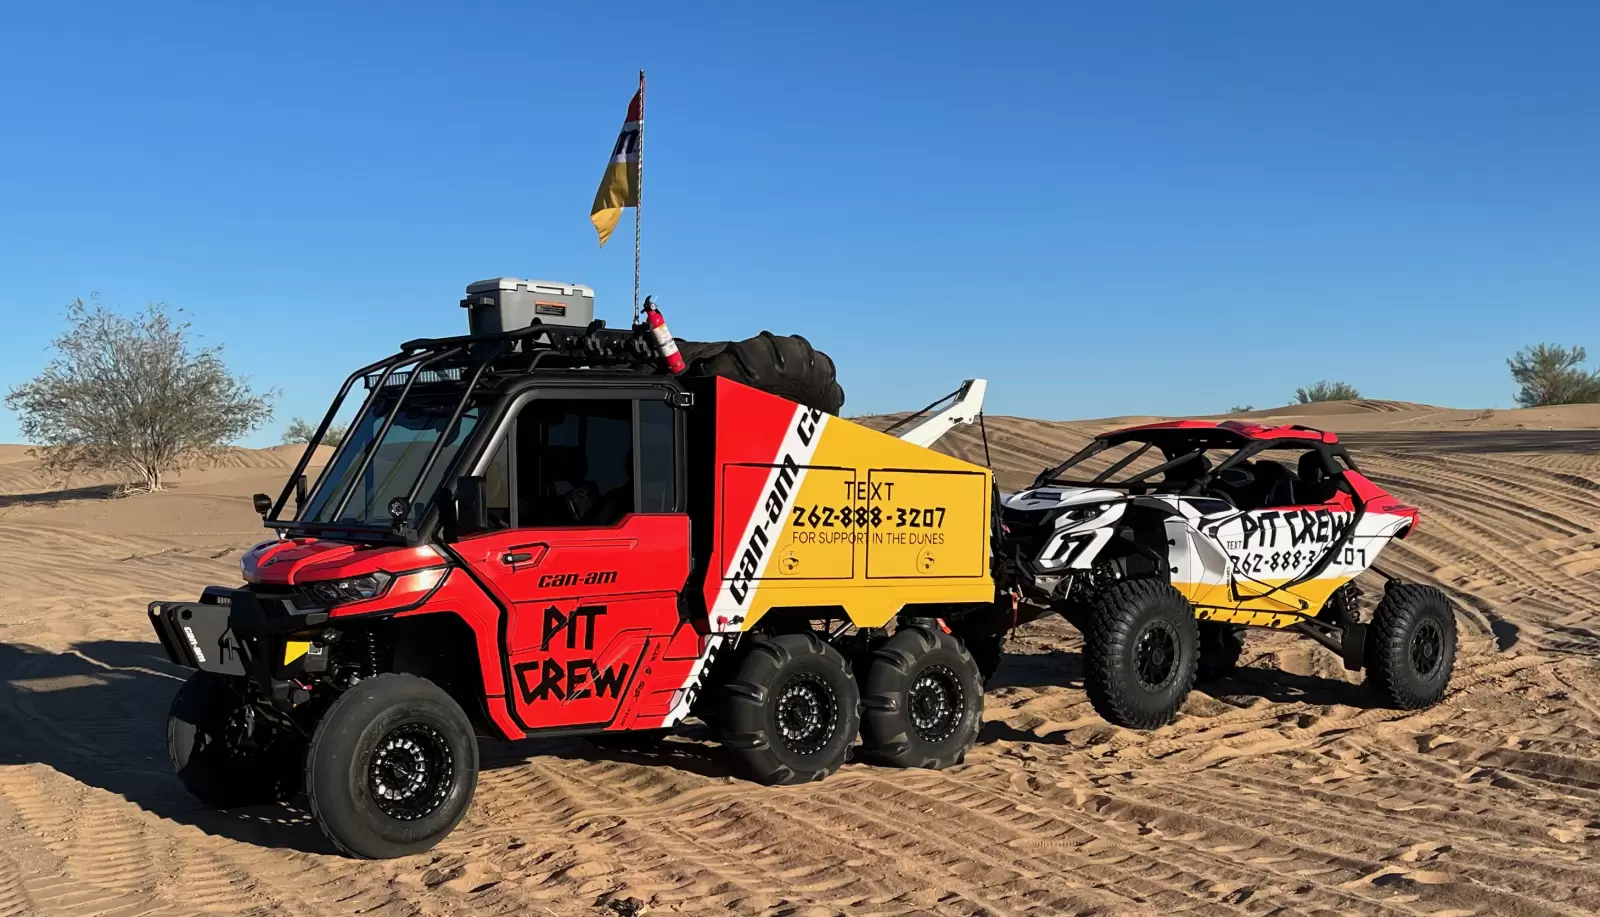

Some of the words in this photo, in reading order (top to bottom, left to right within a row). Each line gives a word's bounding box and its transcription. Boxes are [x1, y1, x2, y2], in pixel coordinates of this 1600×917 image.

[844, 481, 894, 501] TEXT
[792, 504, 946, 529] 262-888-3207
[1240, 510, 1281, 550] PIT
[1283, 508, 1354, 548] CREW
[730, 453, 800, 606] can-am
[792, 531, 816, 544] FOR
[818, 532, 869, 544] SUPPORT
[872, 533, 883, 544] IN
[886, 533, 906, 544] THE
[909, 533, 945, 545] DUNES
[1226, 540, 1242, 550] TEXT
[538, 570, 618, 589] can-am
[541, 604, 608, 653] PIT
[513, 657, 630, 706] CREW
